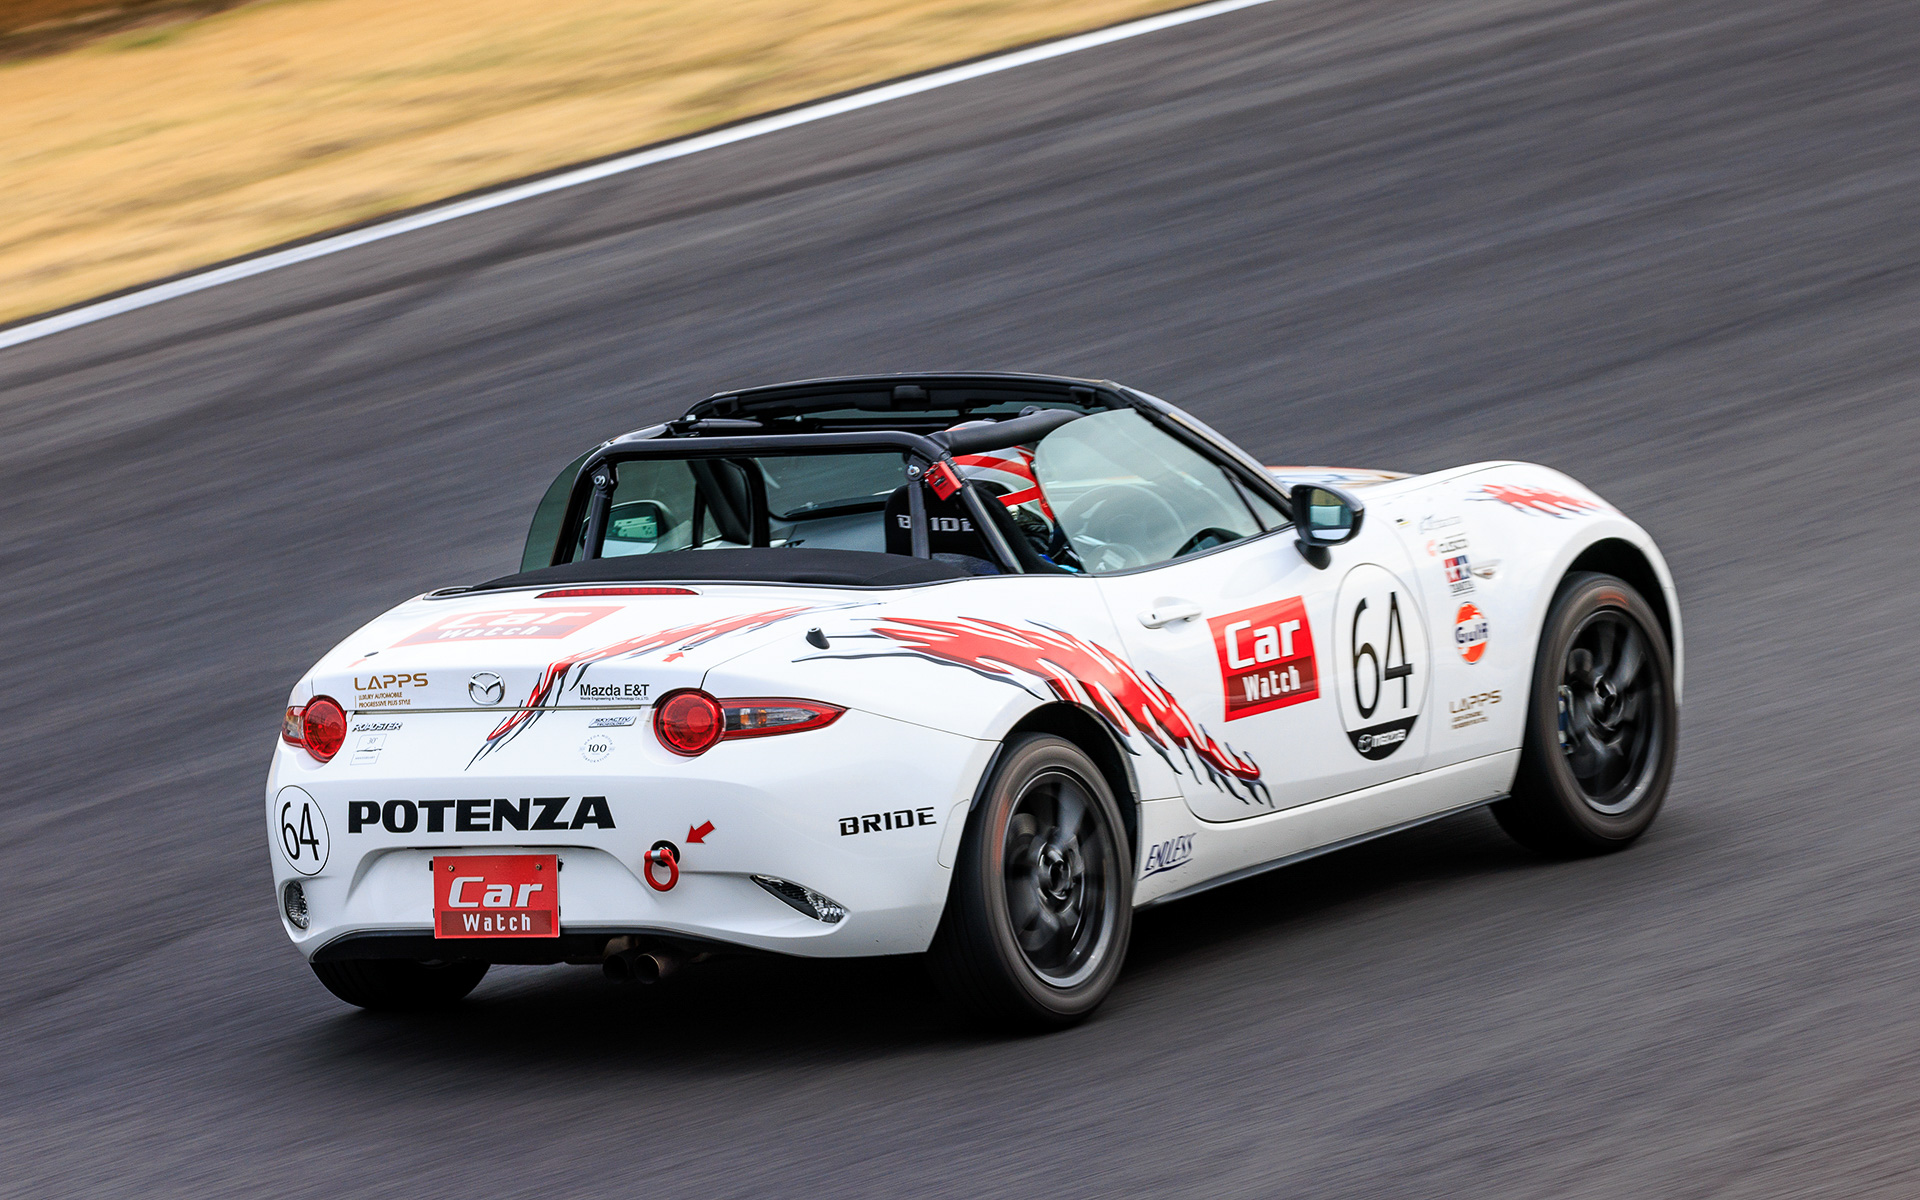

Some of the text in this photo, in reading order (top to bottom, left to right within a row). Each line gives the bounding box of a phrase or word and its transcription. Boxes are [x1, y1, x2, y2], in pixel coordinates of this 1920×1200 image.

[896, 514, 975, 532] BIDE
[437, 611, 593, 631] Car
[437, 625, 542, 640] Watch
[1224, 619, 1301, 670] Car
[1455, 622, 1488, 644] Gulf
[1352, 591, 1414, 720] 64
[354, 672, 429, 691] LAPPS
[580, 683, 650, 696] Mazda E&T
[1242, 665, 1301, 702] Watch
[374, 691, 403, 700] AUTOMOBILE
[1449, 689, 1502, 714] LAPPS
[588, 743, 608, 753] 100
[348, 796, 617, 835] POTENZA
[838, 806, 937, 837] BRIDE
[280, 801, 320, 862] 64
[1144, 832, 1198, 872] ENDLESS
[447, 875, 544, 909] Car
[462, 913, 532, 933] Watch
